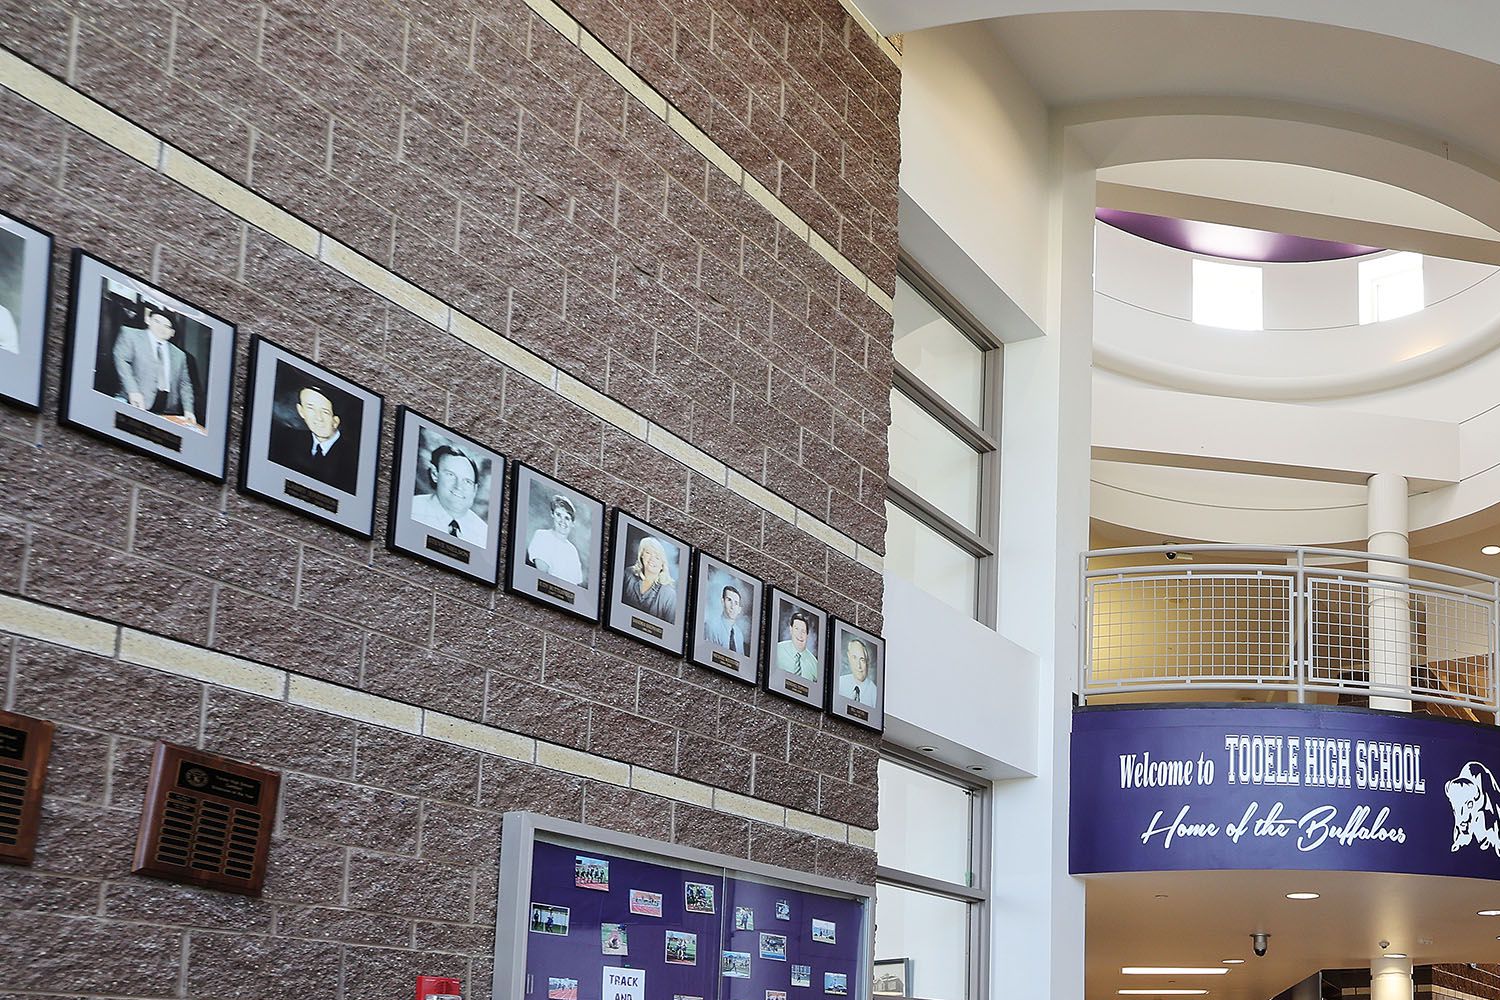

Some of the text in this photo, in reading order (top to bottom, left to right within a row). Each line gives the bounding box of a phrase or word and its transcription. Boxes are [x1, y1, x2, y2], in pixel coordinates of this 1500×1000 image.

[1119, 734, 1426, 794] Welcome to TOOELE HIGH SCHOOL
[1141, 801, 1407, 852] Home of the Buffaloes
[609, 974, 639, 987] TRACK
